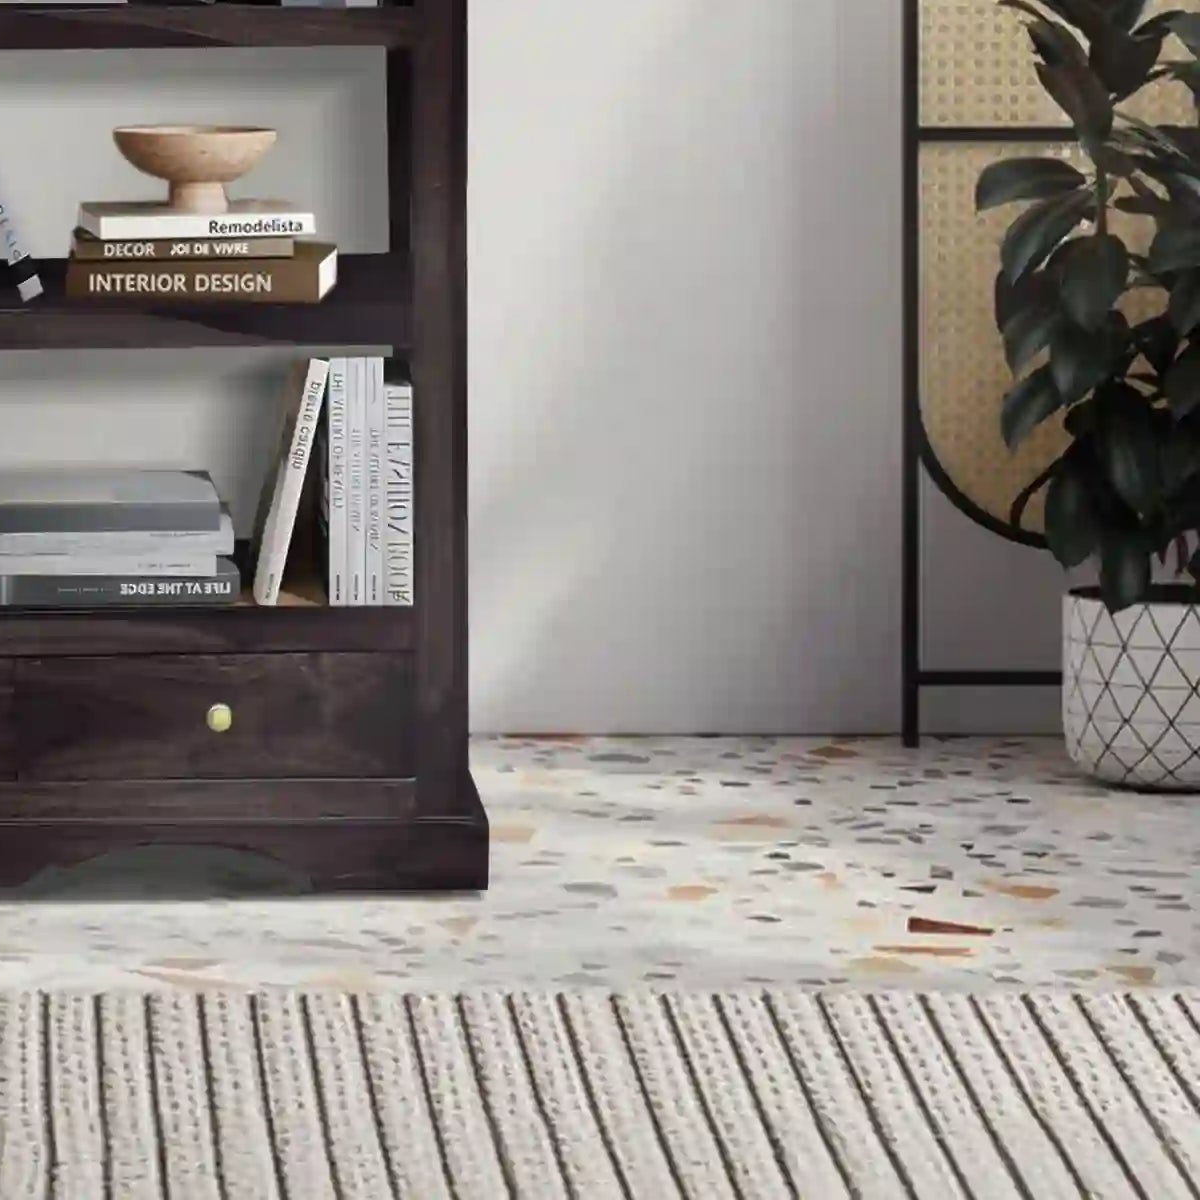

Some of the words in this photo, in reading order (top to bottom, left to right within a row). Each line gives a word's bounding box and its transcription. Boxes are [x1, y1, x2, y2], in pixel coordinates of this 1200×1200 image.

[208, 218, 304, 234] Remodelista
[103, 242, 155, 257] DECOR
[194, 242, 209, 255] DE
[213, 242, 249, 255] VIVRE
[89, 273, 187, 293] INTERIOR
[194, 273, 273, 293] DESIGN
